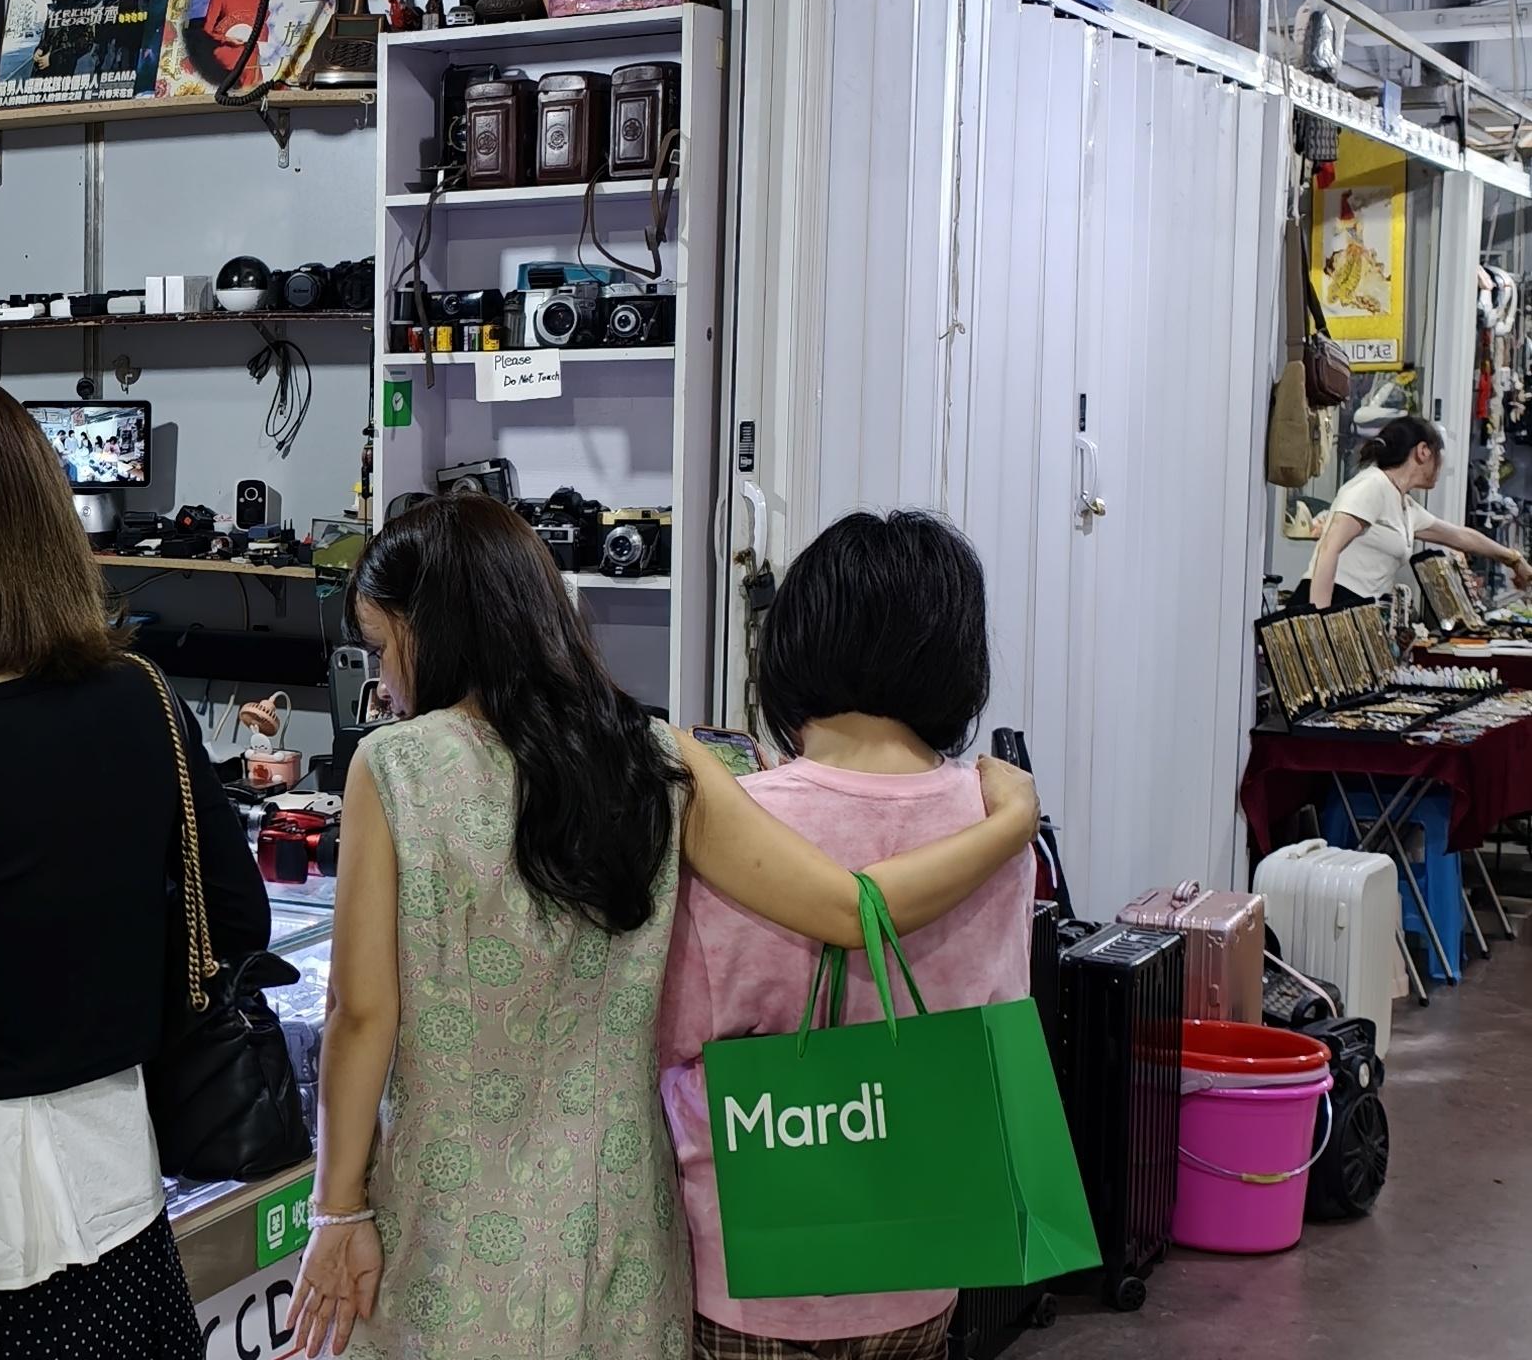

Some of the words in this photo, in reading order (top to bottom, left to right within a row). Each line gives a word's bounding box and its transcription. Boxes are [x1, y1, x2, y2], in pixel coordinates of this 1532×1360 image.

[494, 355, 532, 371] Please
[503, 375, 517, 388] Do
[518, 372, 534, 386] Not
[724, 1082, 887, 1152] Mardi
